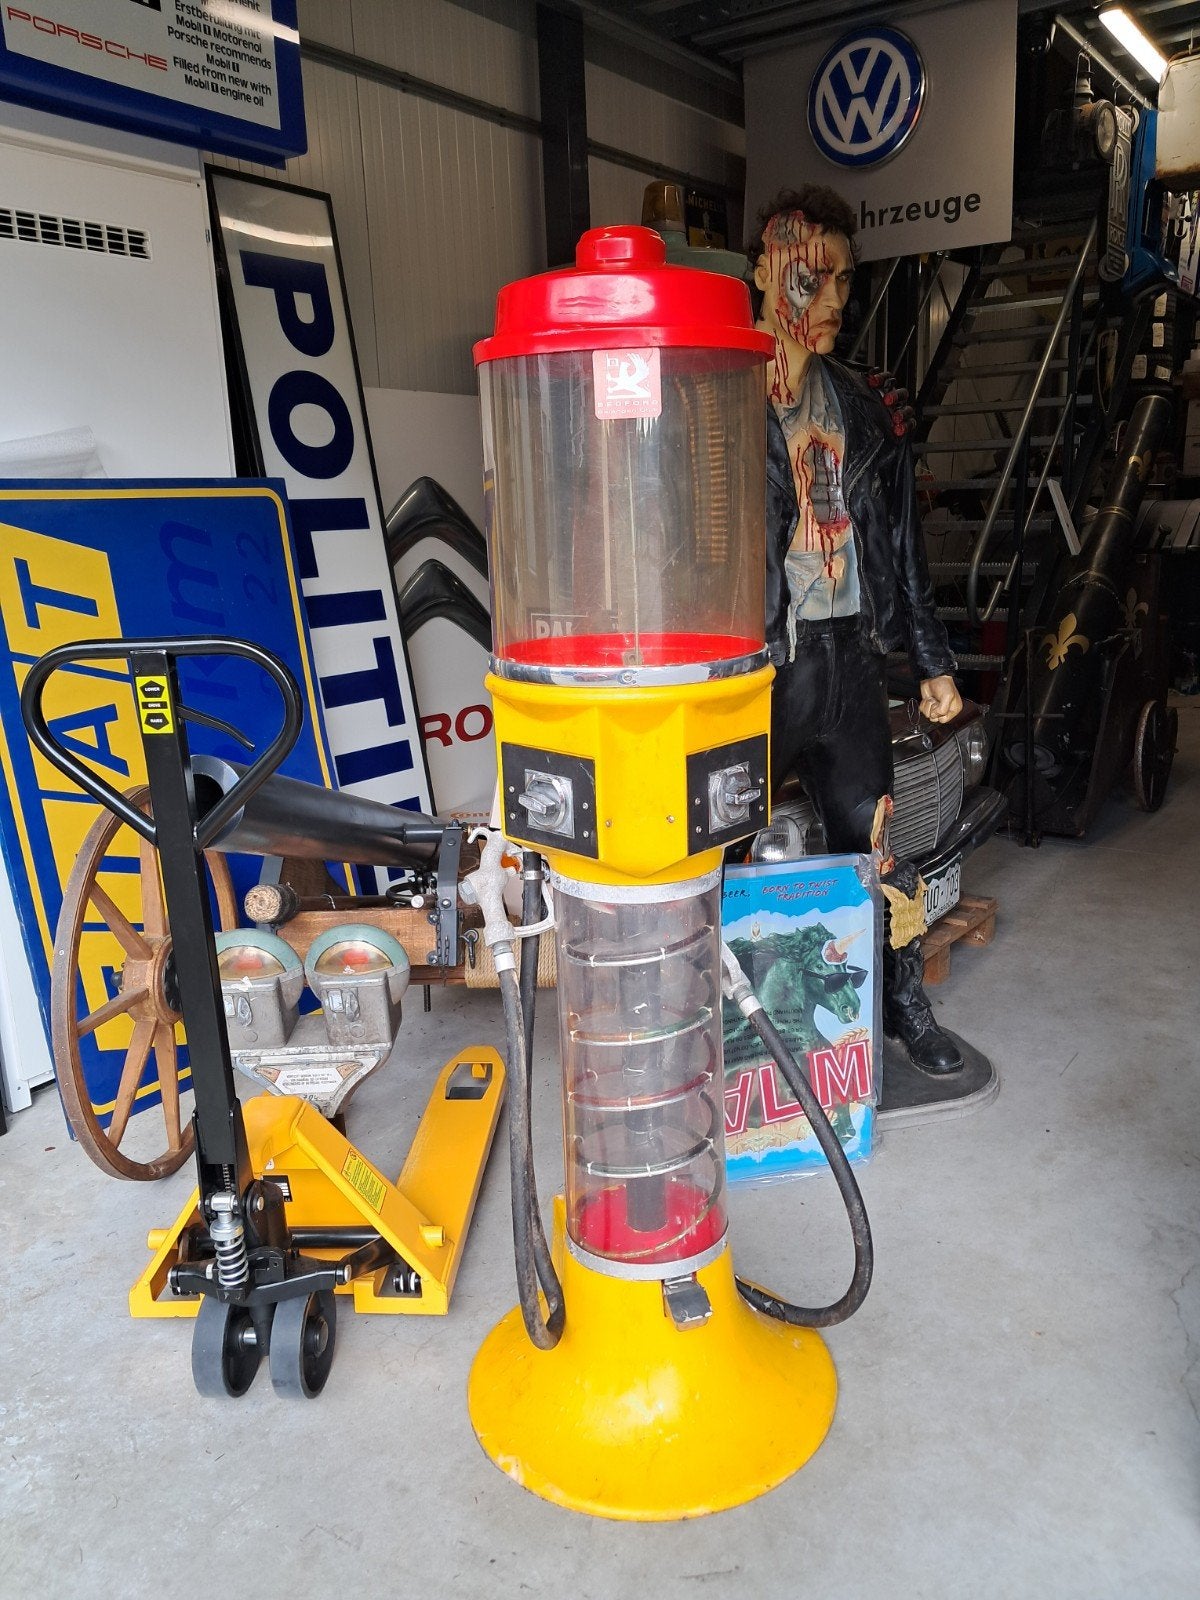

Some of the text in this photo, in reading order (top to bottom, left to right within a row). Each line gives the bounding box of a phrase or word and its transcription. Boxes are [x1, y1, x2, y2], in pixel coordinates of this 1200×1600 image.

[7, 6, 168, 72] PORSCHE
[176, 14, 202, 32] Mobil
[167, 26, 272, 69] Porsche recommends
[206, 53, 231, 70] Mobil
[173, 56, 272, 96] Filled from new with
[184, 74, 210, 91] Mobil
[220, 85, 251, 103] engine
[254, 96, 264, 106] oil
[420, 704, 493, 747] RO
[777, 889, 829, 901] TRADITION
[793, 881, 806, 890] TO
